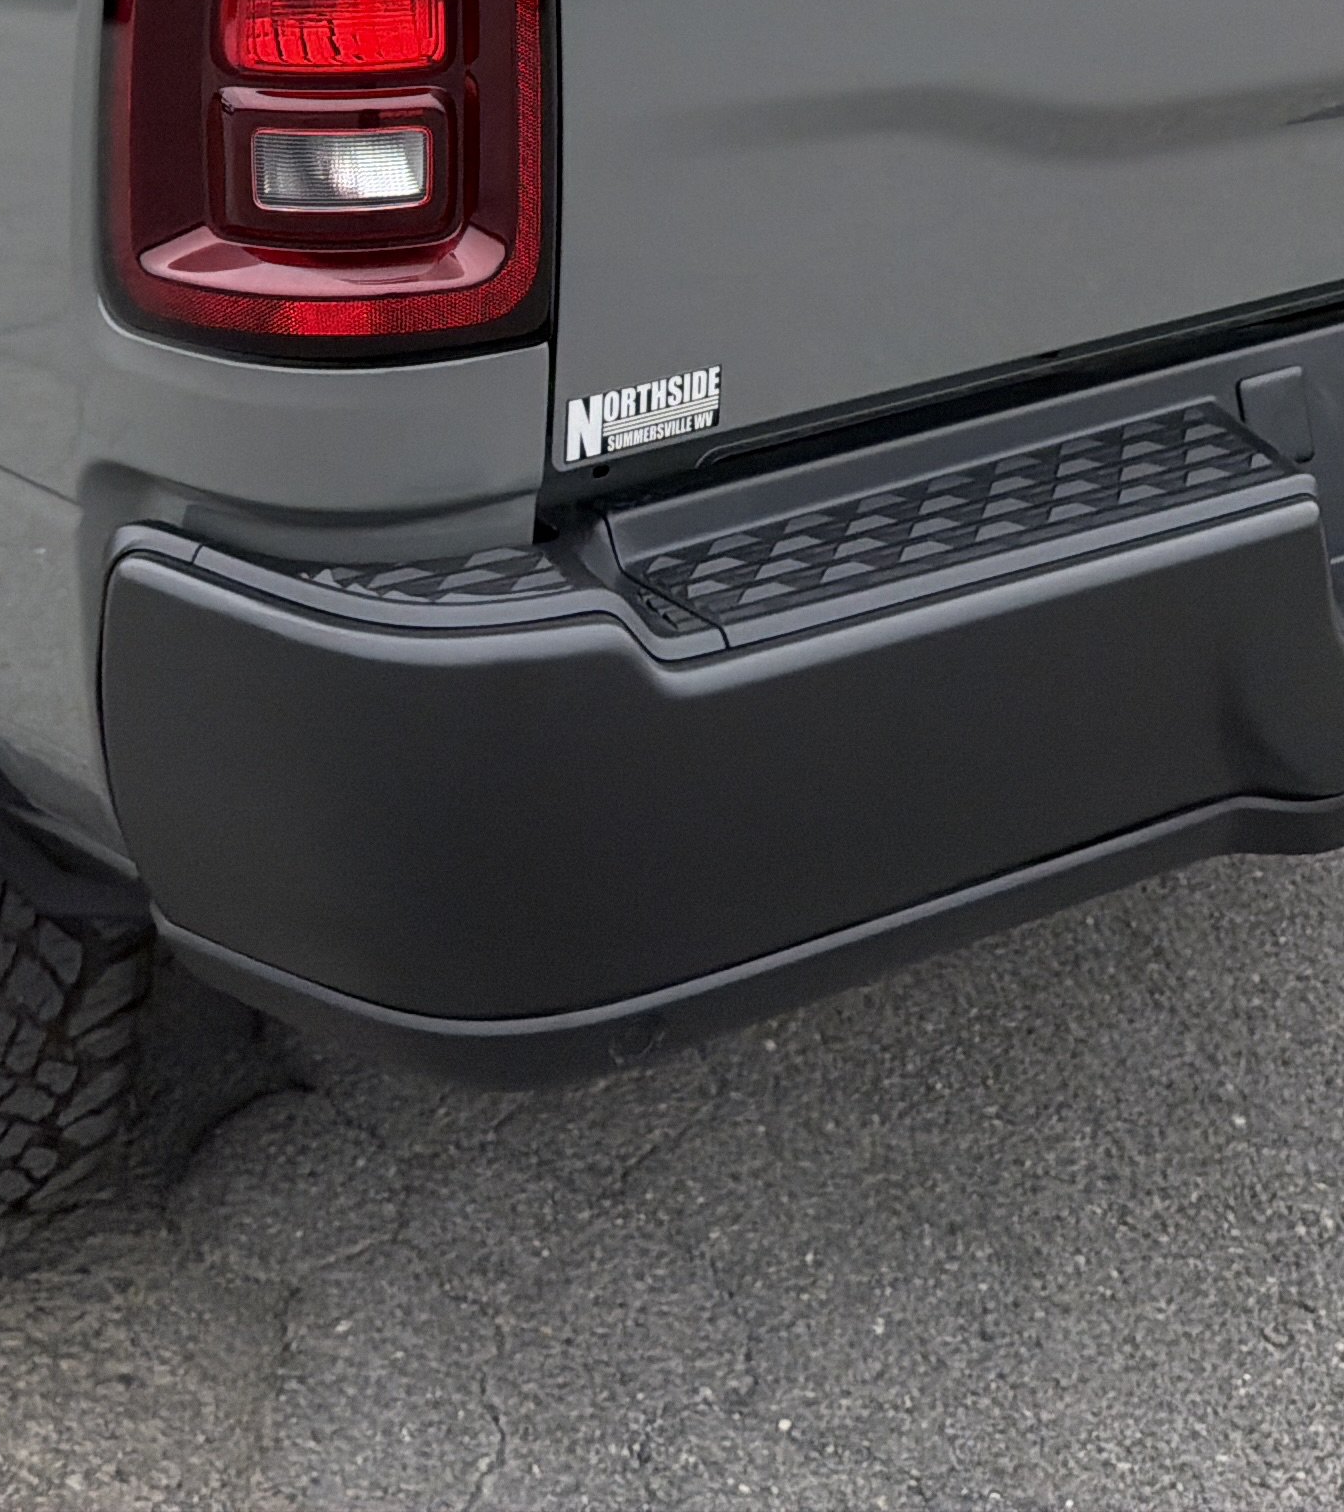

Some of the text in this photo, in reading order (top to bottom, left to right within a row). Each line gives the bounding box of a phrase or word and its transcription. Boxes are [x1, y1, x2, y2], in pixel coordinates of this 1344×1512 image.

[565, 364, 720, 462] NORTHSIDE
[607, 410, 714, 452] SUMMERSVILLE WV
